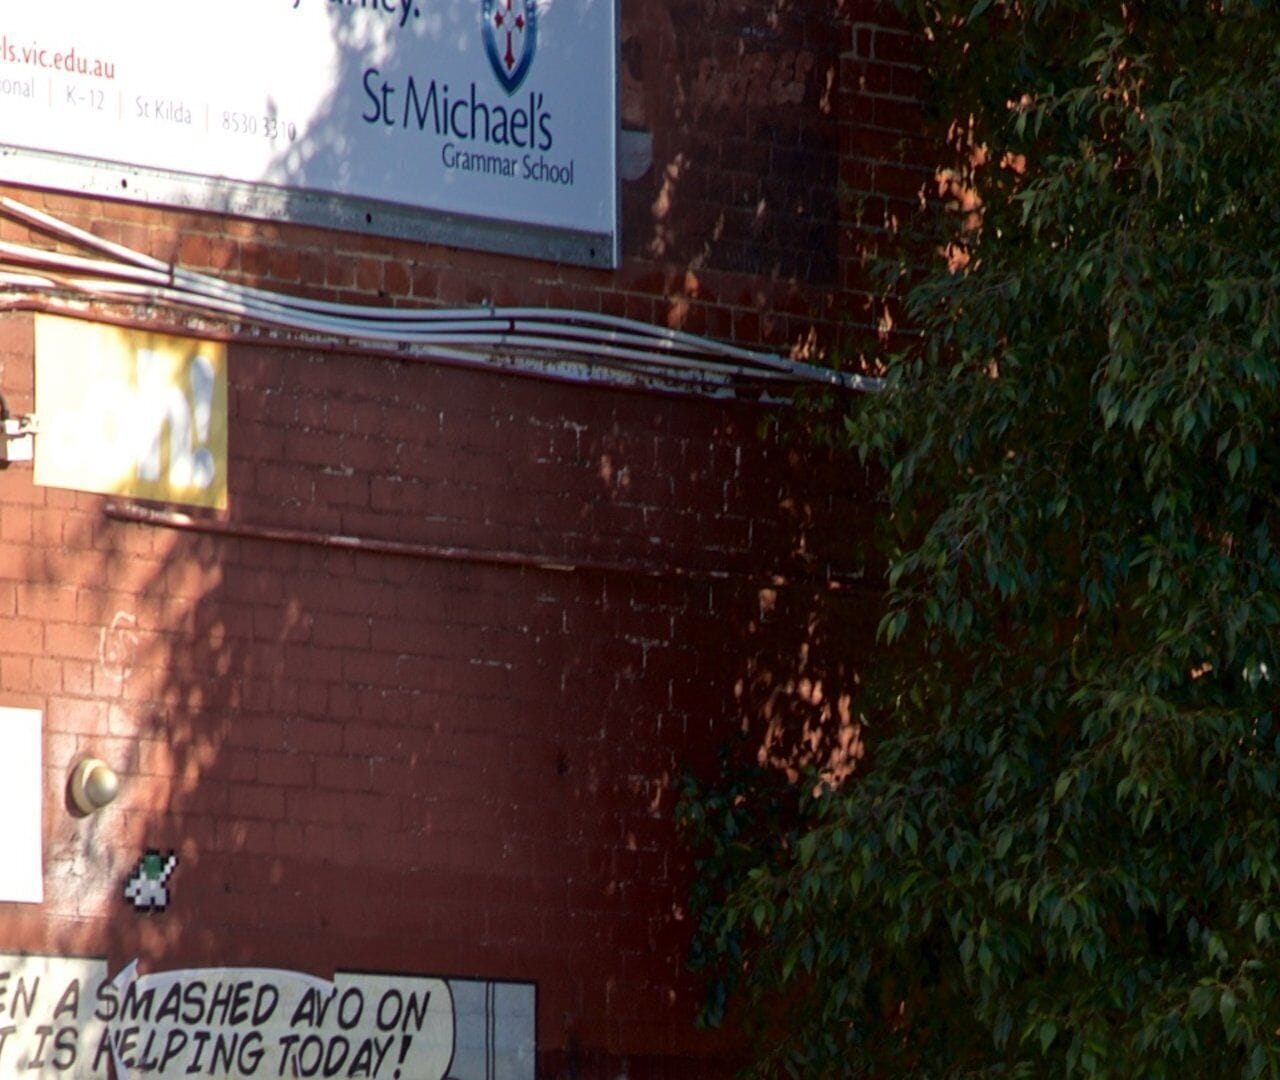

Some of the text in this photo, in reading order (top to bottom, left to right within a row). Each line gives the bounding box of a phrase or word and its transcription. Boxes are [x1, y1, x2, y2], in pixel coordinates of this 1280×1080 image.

[136, 97, 151, 118] St
[155, 98, 192, 125] Kilda
[222, 111, 257, 136] 8530
[362, 68, 553, 151] St Michael's
[442, 142, 575, 186] Grammar School
[53, 978, 81, 1020] A
[94, 979, 280, 1026] SMASHED
[376, 988, 432, 1032] ON
[27, 1026, 79, 1071] IS
[91, 1025, 266, 1076] HELPING
[278, 1034, 414, 1080] TODAY!
